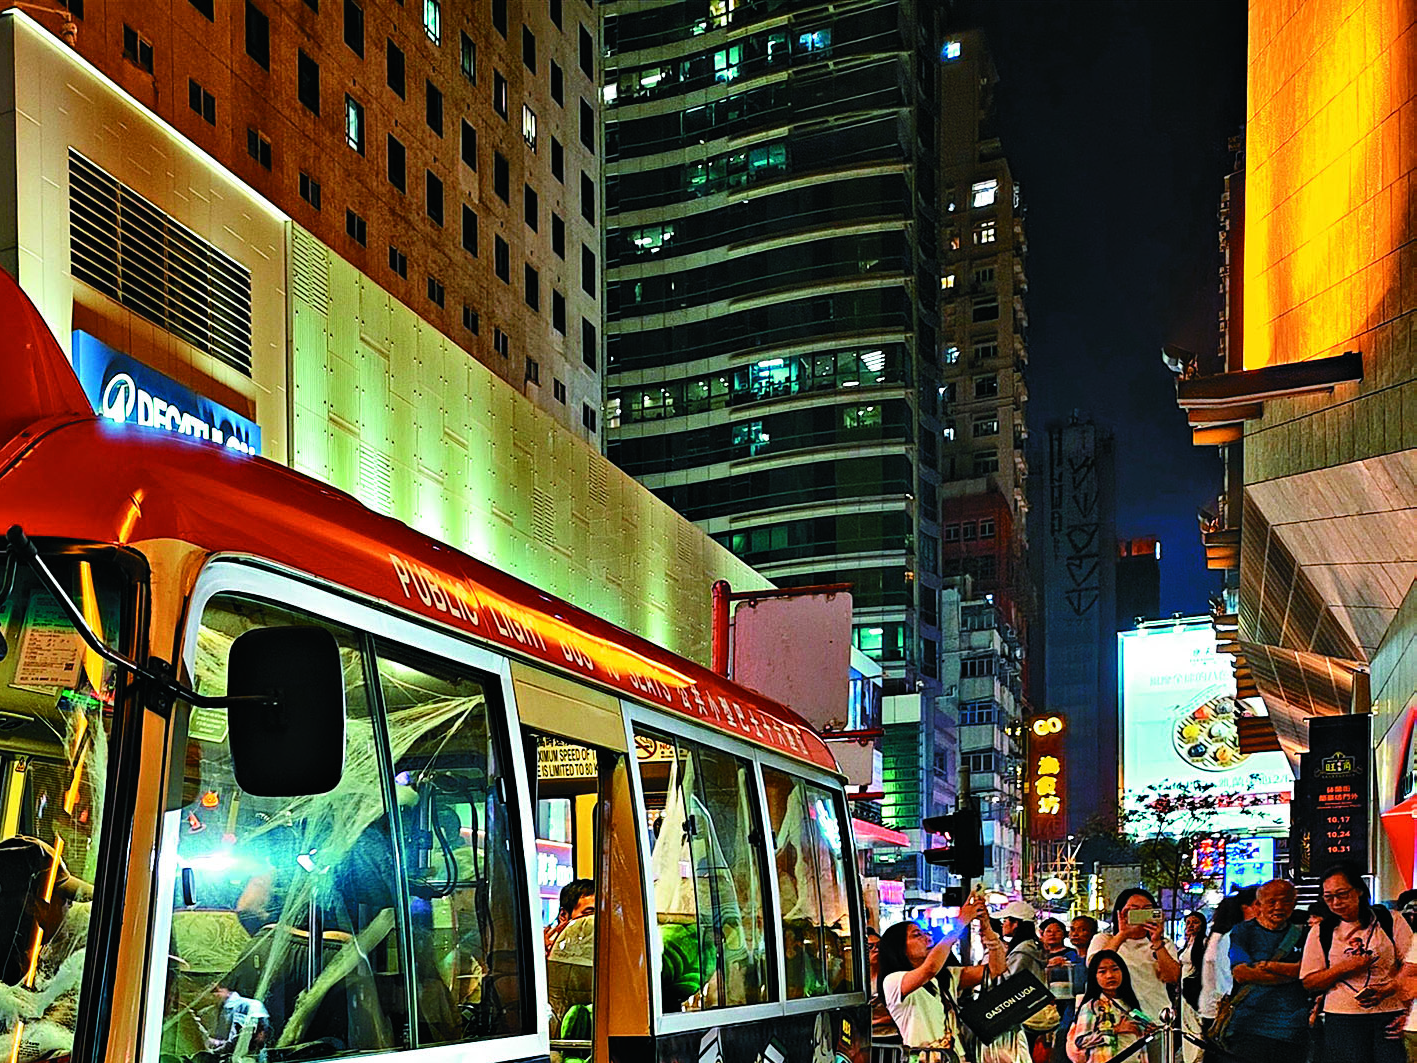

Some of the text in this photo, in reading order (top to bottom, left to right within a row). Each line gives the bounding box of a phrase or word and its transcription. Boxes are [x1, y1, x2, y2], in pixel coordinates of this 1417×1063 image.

[388, 553, 479, 626] PUBLIC
[489, 605, 547, 652] LIGHT
[560, 643, 594, 671] BUS
[629, 668, 673, 702] SEATS
[559, 748, 581, 762] SPEED
[549, 764, 575, 777] LIMITED
[575, 763, 585, 776] TO
[1326, 816, 1351, 824] 10.17
[985, 985, 1036, 1020] GASTON LUGA
